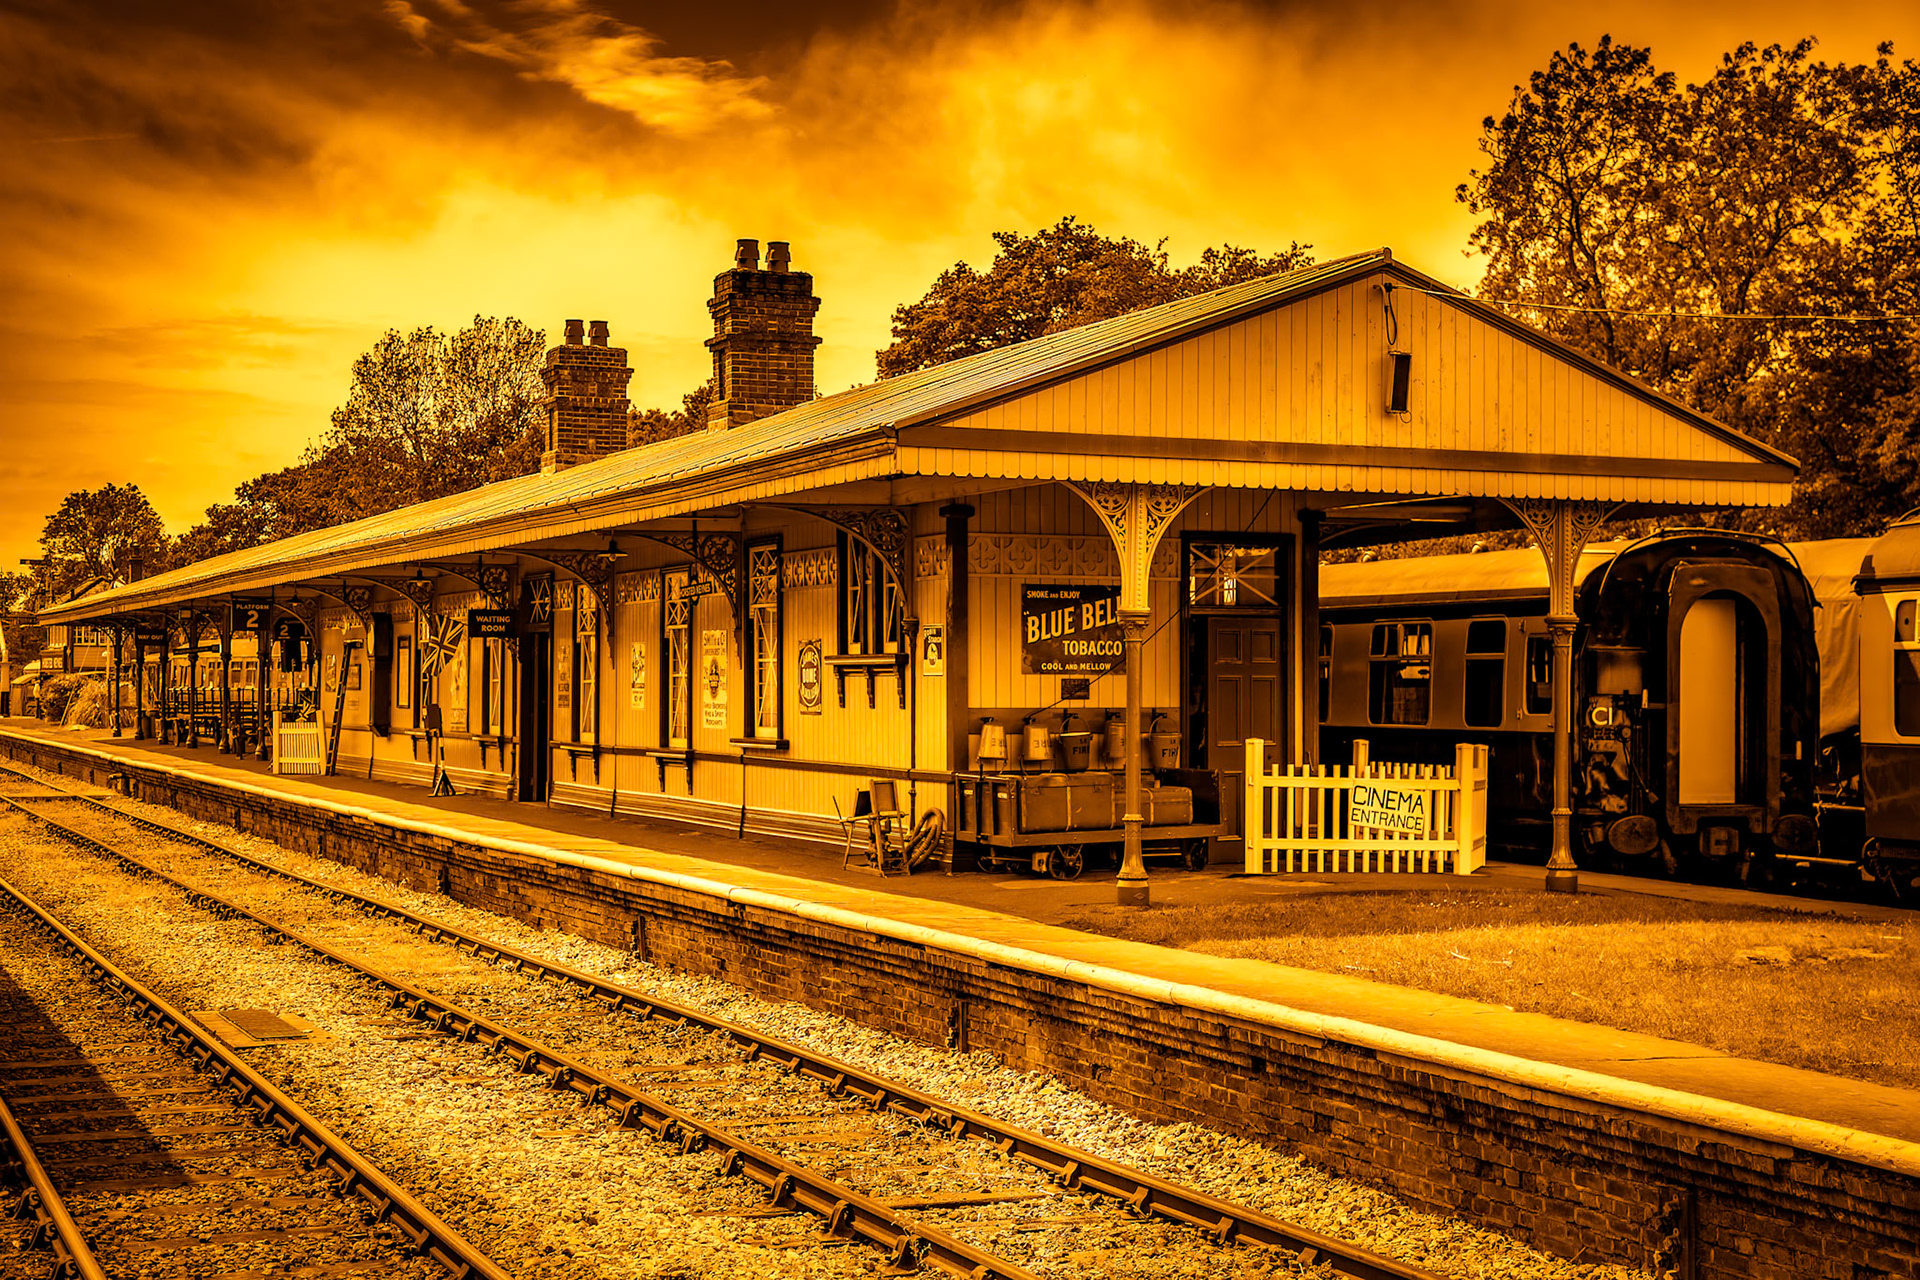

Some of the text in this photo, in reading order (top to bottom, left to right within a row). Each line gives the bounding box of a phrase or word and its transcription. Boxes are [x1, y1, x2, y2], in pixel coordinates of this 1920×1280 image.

[1026, 590, 1049, 599] SMOKE
[1060, 590, 1081, 599] ENJOY
[236, 603, 270, 611] PLATFORM
[246, 610, 259, 628] 2
[475, 615, 511, 623] WAITING
[279, 624, 289, 636] 2
[481, 624, 506, 632] ROOM
[1062, 640, 1123, 656] TOBACCO
[1041, 662, 1063, 671] COOL
[1079, 662, 1112, 671] MELLOW
[1352, 785, 1424, 815] CINEMA
[1351, 807, 1423, 831] ENTRANCE
